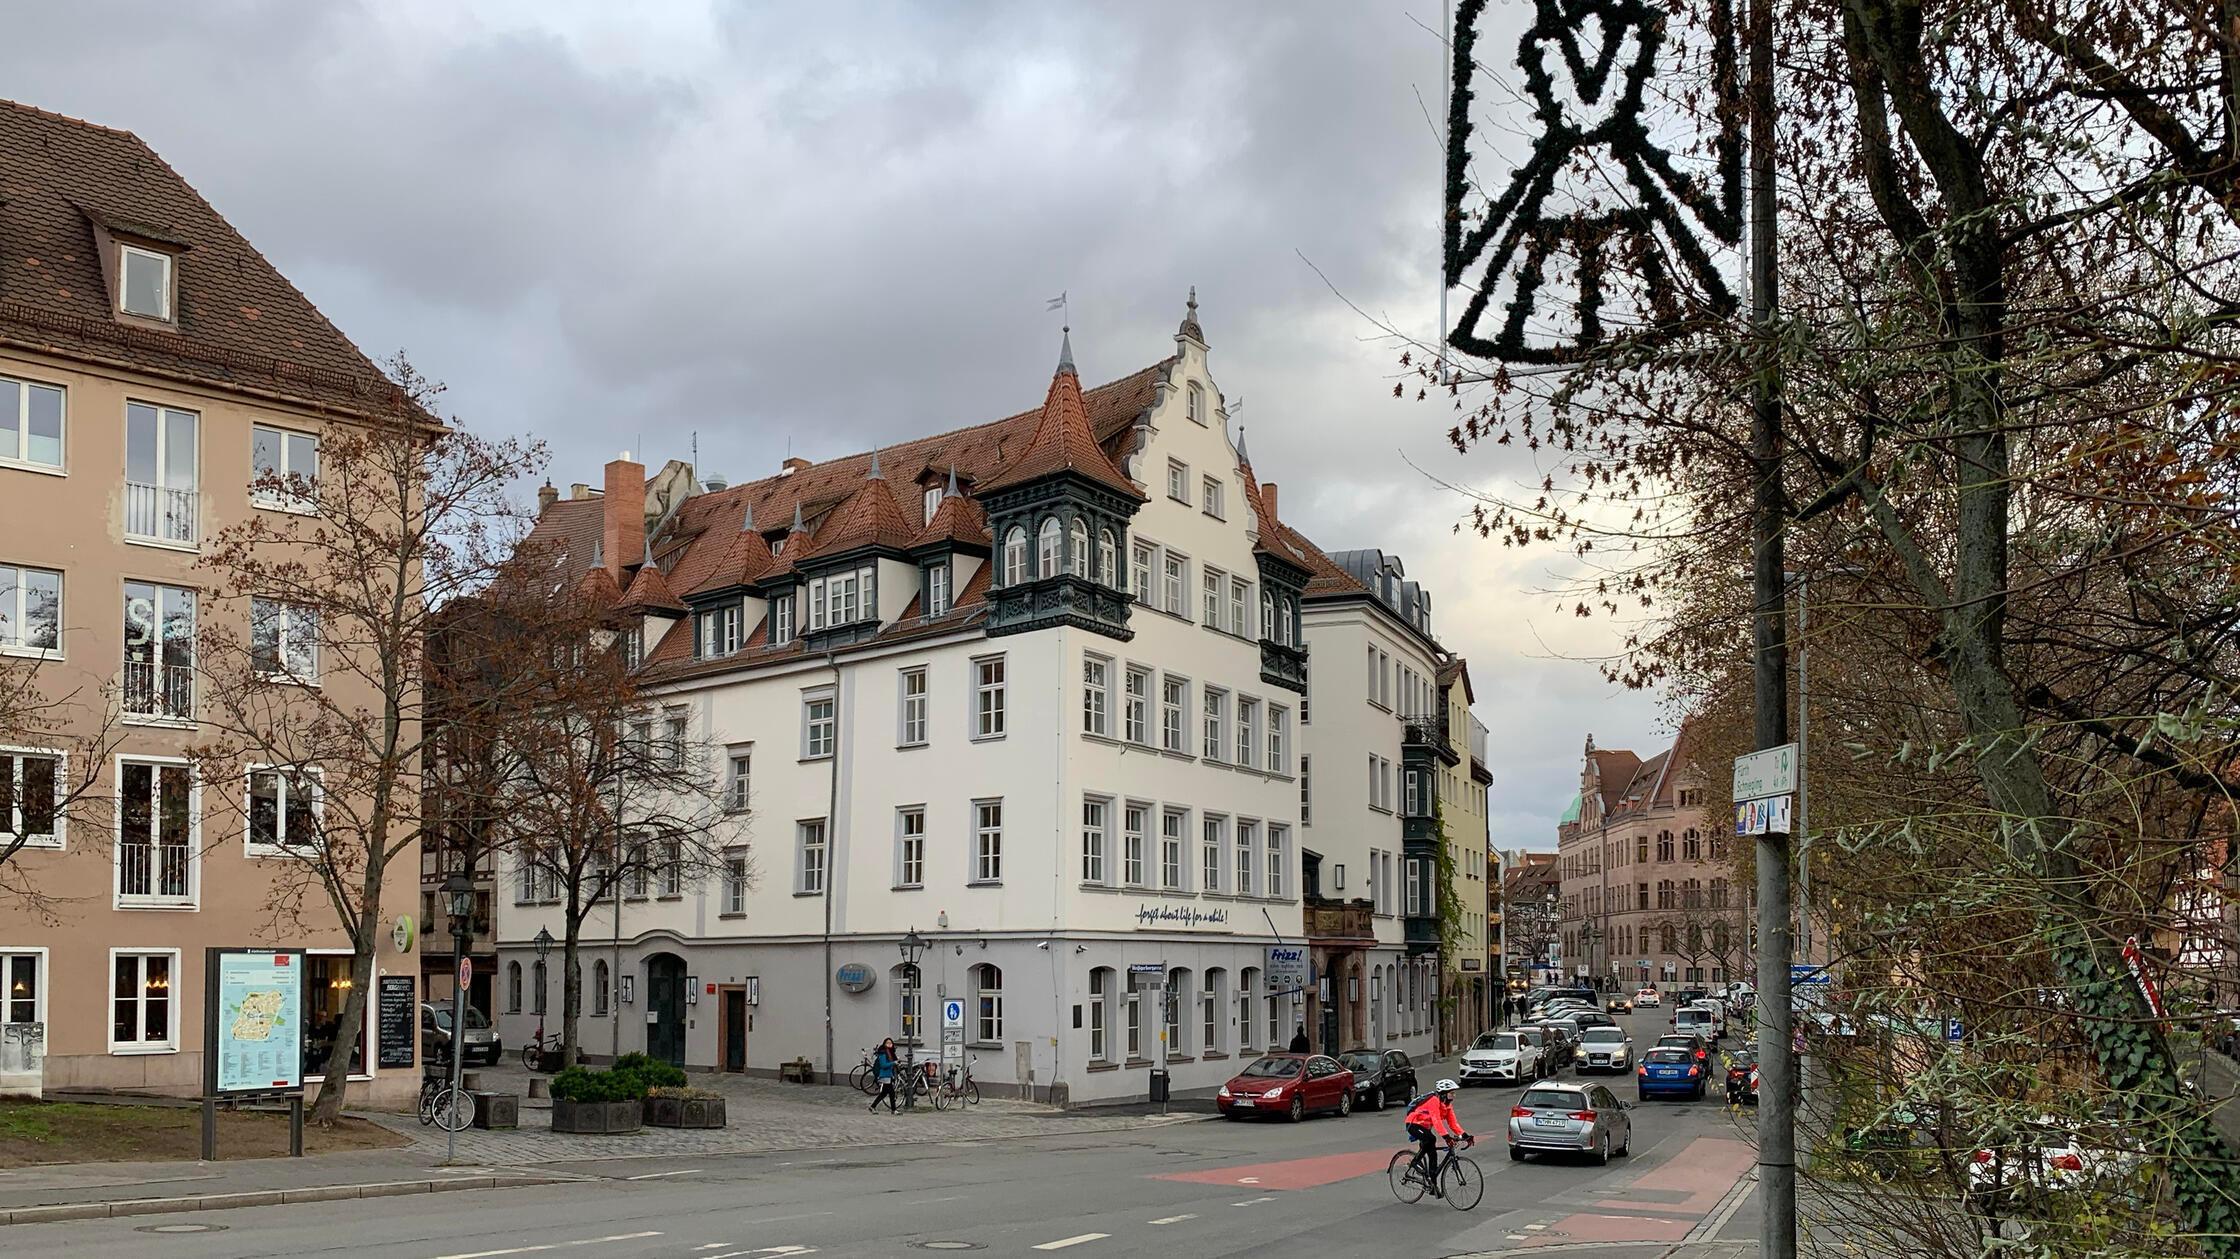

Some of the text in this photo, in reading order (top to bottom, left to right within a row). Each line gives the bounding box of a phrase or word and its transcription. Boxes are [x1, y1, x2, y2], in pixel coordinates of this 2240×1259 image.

[1135, 903, 1159, 925] forget
[1160, 904, 1179, 921] about
[1180, 905, 1192, 926] life
[1192, 907, 1202, 927] for
[1271, 948, 1303, 962] Frizz!
